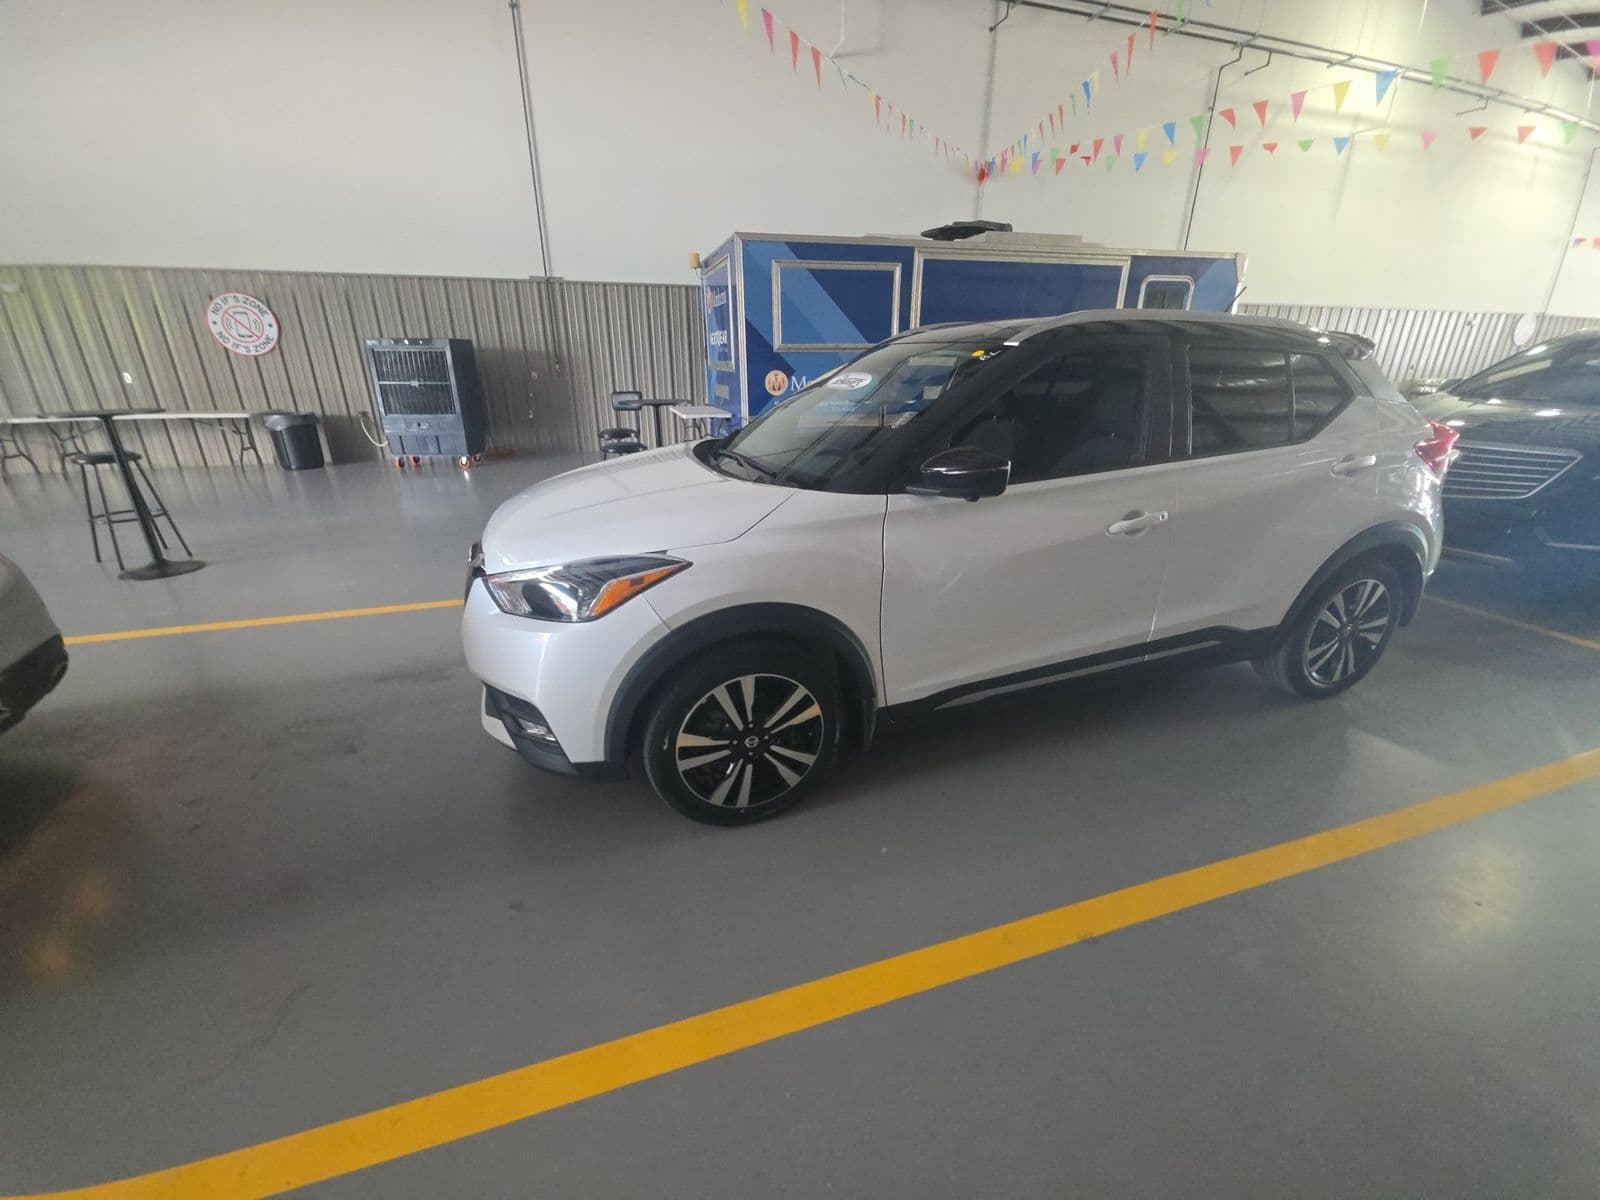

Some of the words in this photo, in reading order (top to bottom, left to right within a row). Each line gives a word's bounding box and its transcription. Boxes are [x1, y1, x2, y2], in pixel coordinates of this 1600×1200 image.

[211, 302, 222, 316] NO
[242, 296, 270, 318] ZONE
[216, 330, 231, 344] NO
[254, 334, 274, 353] ZONE
